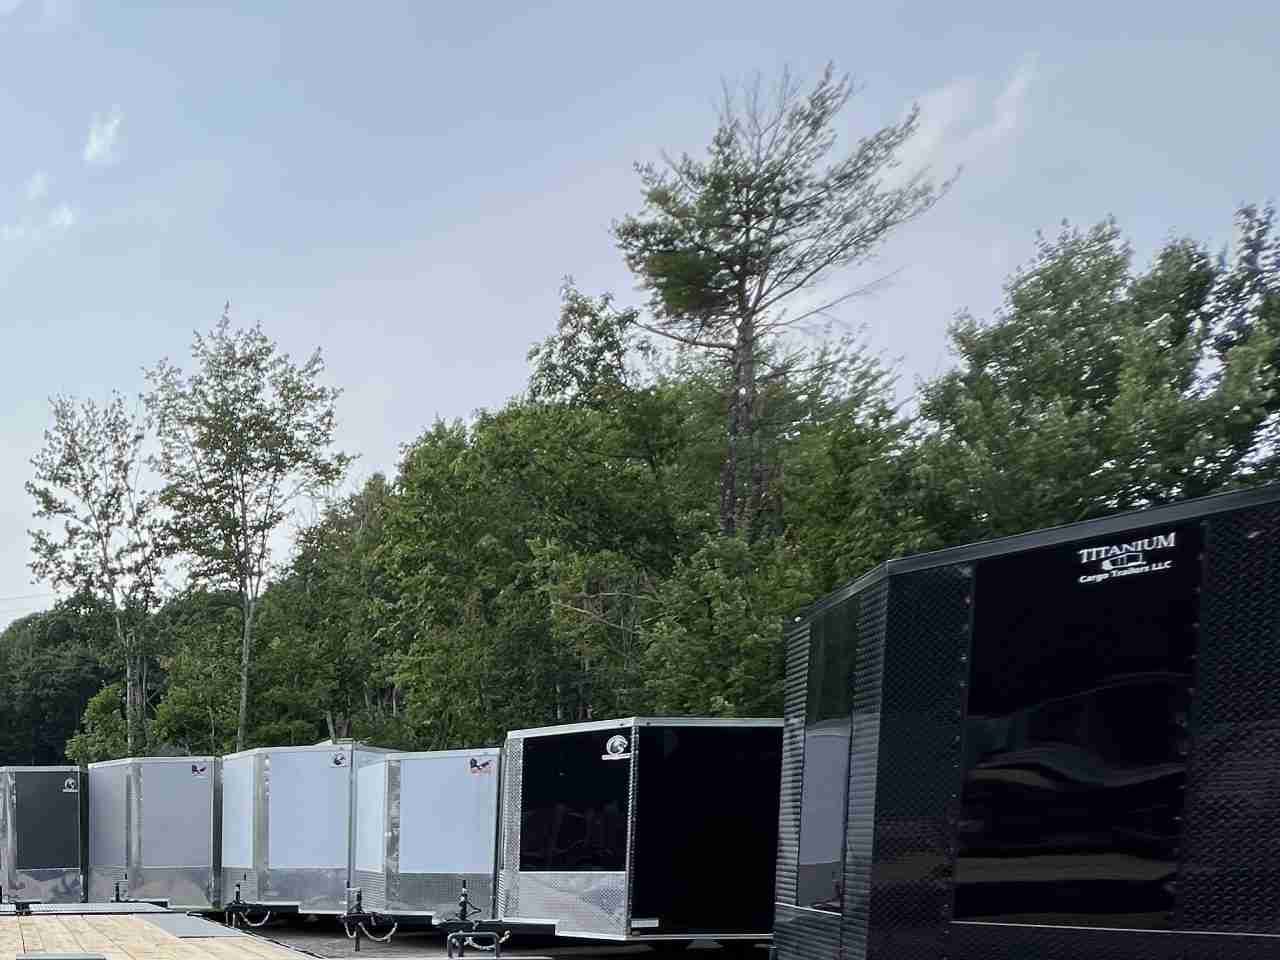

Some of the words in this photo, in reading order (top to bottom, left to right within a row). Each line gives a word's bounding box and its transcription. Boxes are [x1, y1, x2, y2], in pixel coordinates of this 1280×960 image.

[1077, 531, 1176, 564] TITANIUM
[1078, 573, 1110, 584] Cargo
[1110, 565, 1150, 577] Trailers
[1151, 560, 1173, 571] LLC
